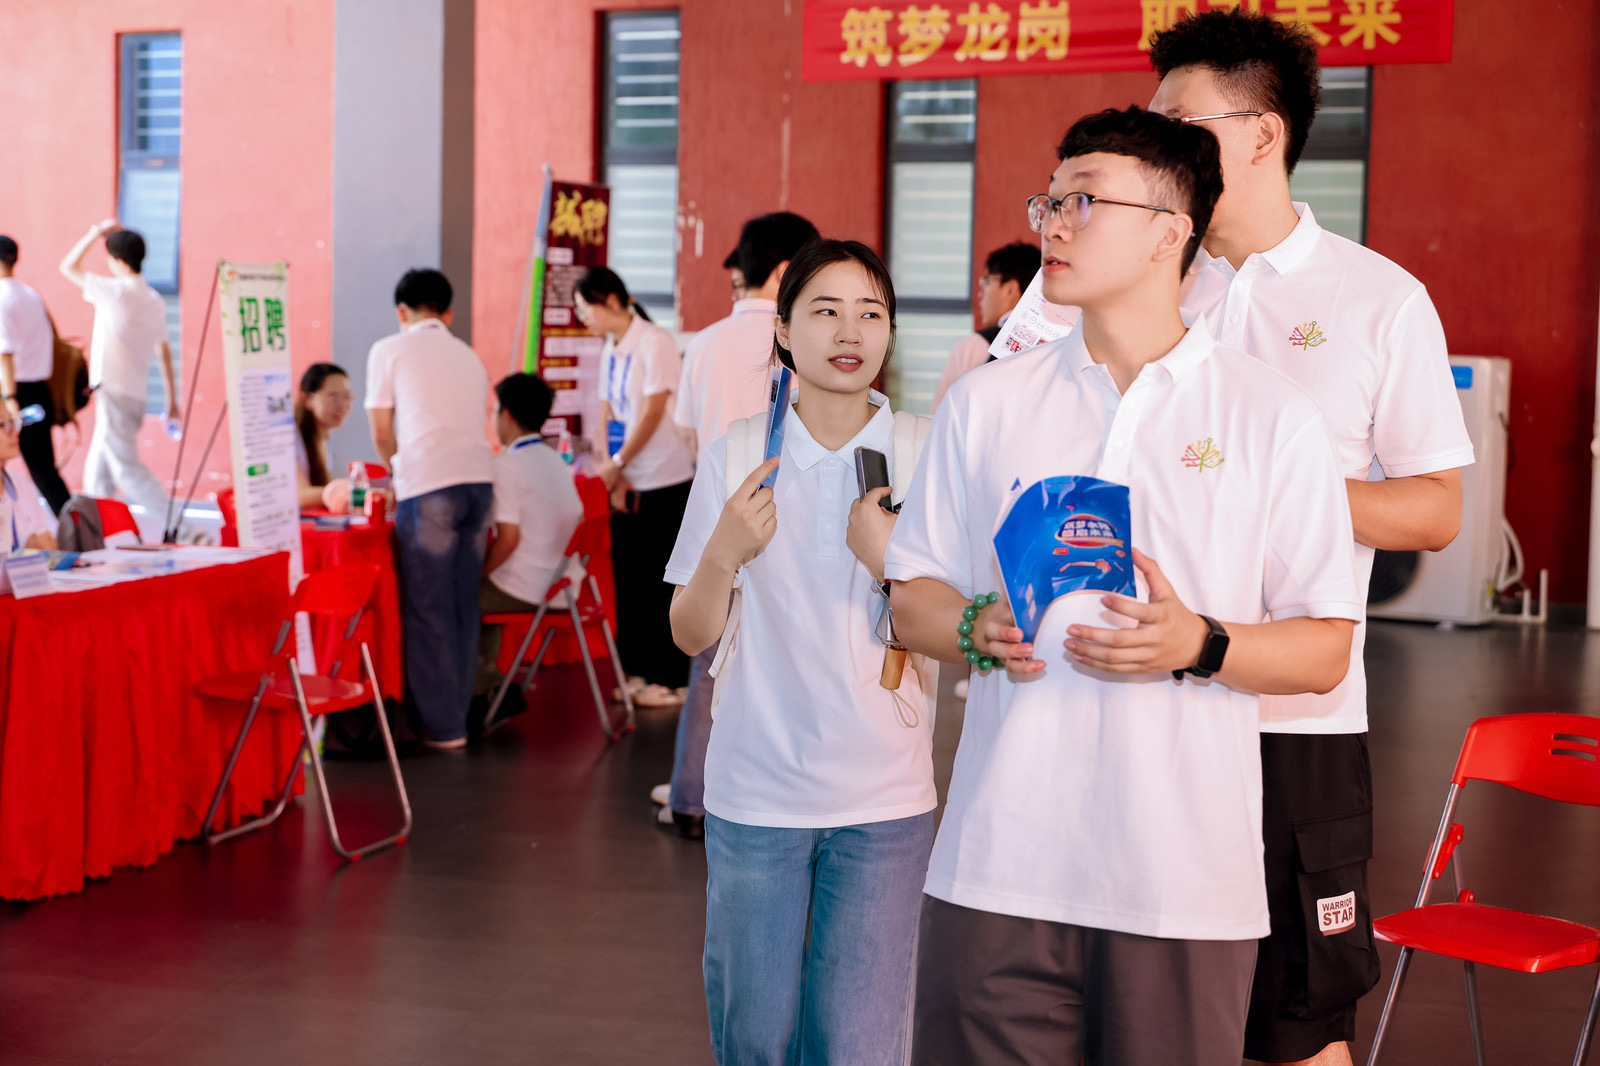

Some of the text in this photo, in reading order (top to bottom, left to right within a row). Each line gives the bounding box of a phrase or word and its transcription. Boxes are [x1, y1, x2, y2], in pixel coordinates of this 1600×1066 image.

[840, 0, 1402, 67] 筑梦龙岗 职未来
[239, 296, 286, 353] 招聘
[1322, 897, 1353, 912] WARRIOR
[1323, 907, 1353, 926] STAR
